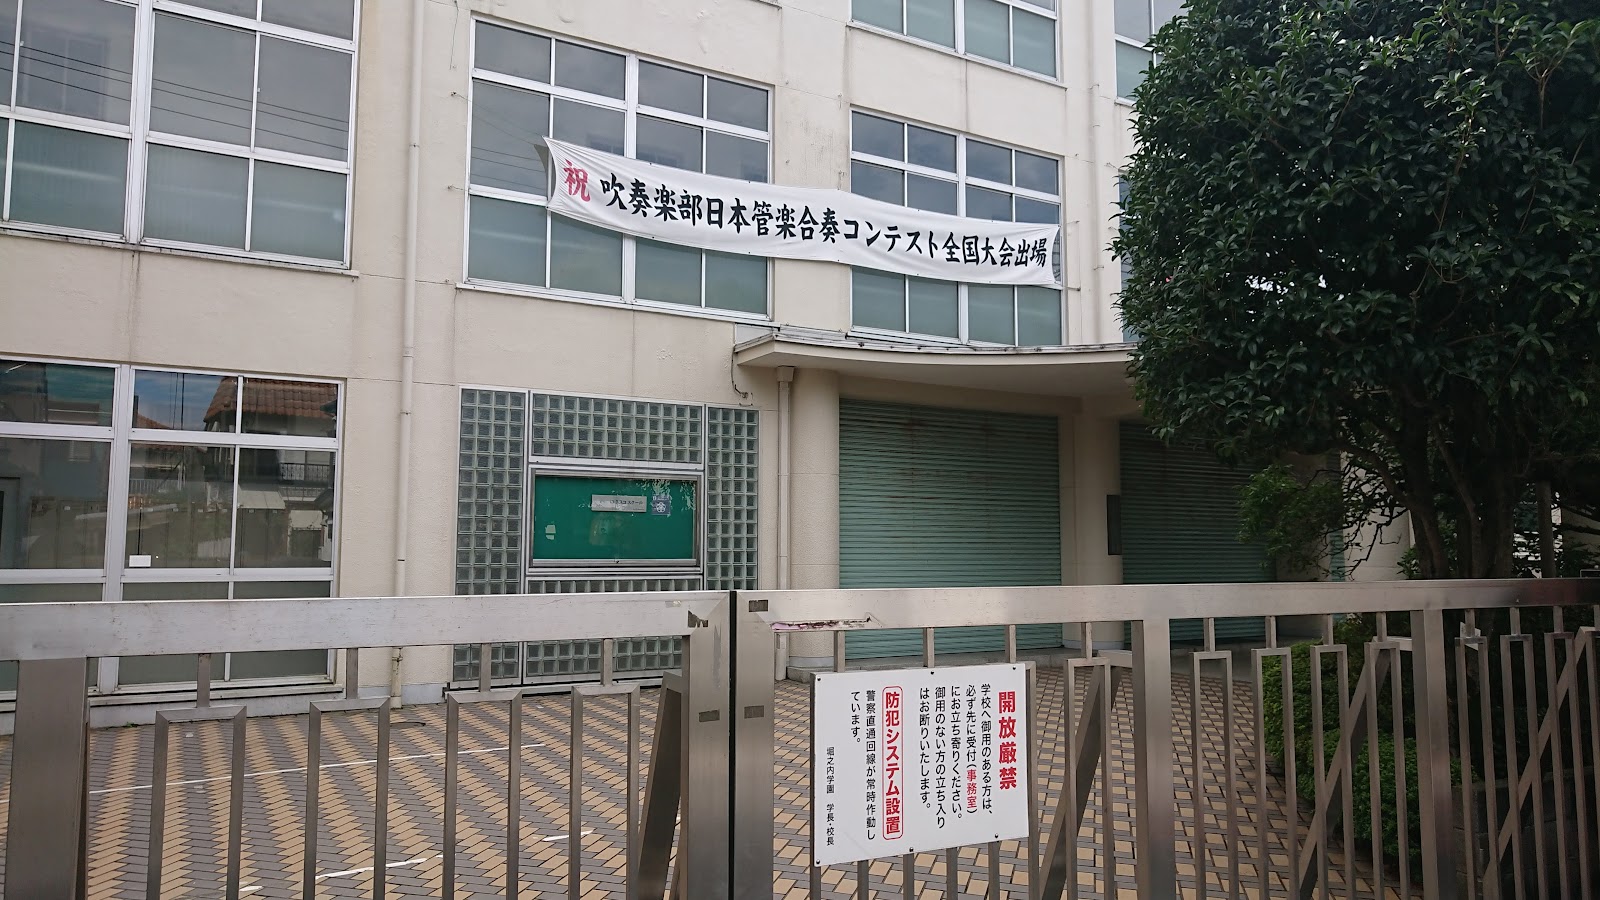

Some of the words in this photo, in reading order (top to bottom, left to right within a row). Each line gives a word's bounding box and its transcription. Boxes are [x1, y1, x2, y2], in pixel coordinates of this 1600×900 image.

[563, 158, 591, 202] 祝
[599, 172, 1048, 268] 吹奏楽部日本管楽合奏コンテスト全国大会出場
[850, 690, 861, 744] ています。
[865, 690, 876, 840] 警察直通回線が常時作動し
[885, 692, 900, 835] 防犯システム設置
[919, 687, 931, 809] はお断りいたします。
[934, 686, 947, 829] 御用のない方の立ち入り
[950, 685, 963, 819] にお立ち寄りください。
[980, 683, 993, 815] 学校へ御用のある方は、
[998, 691, 1017, 790] 開放厳禁
